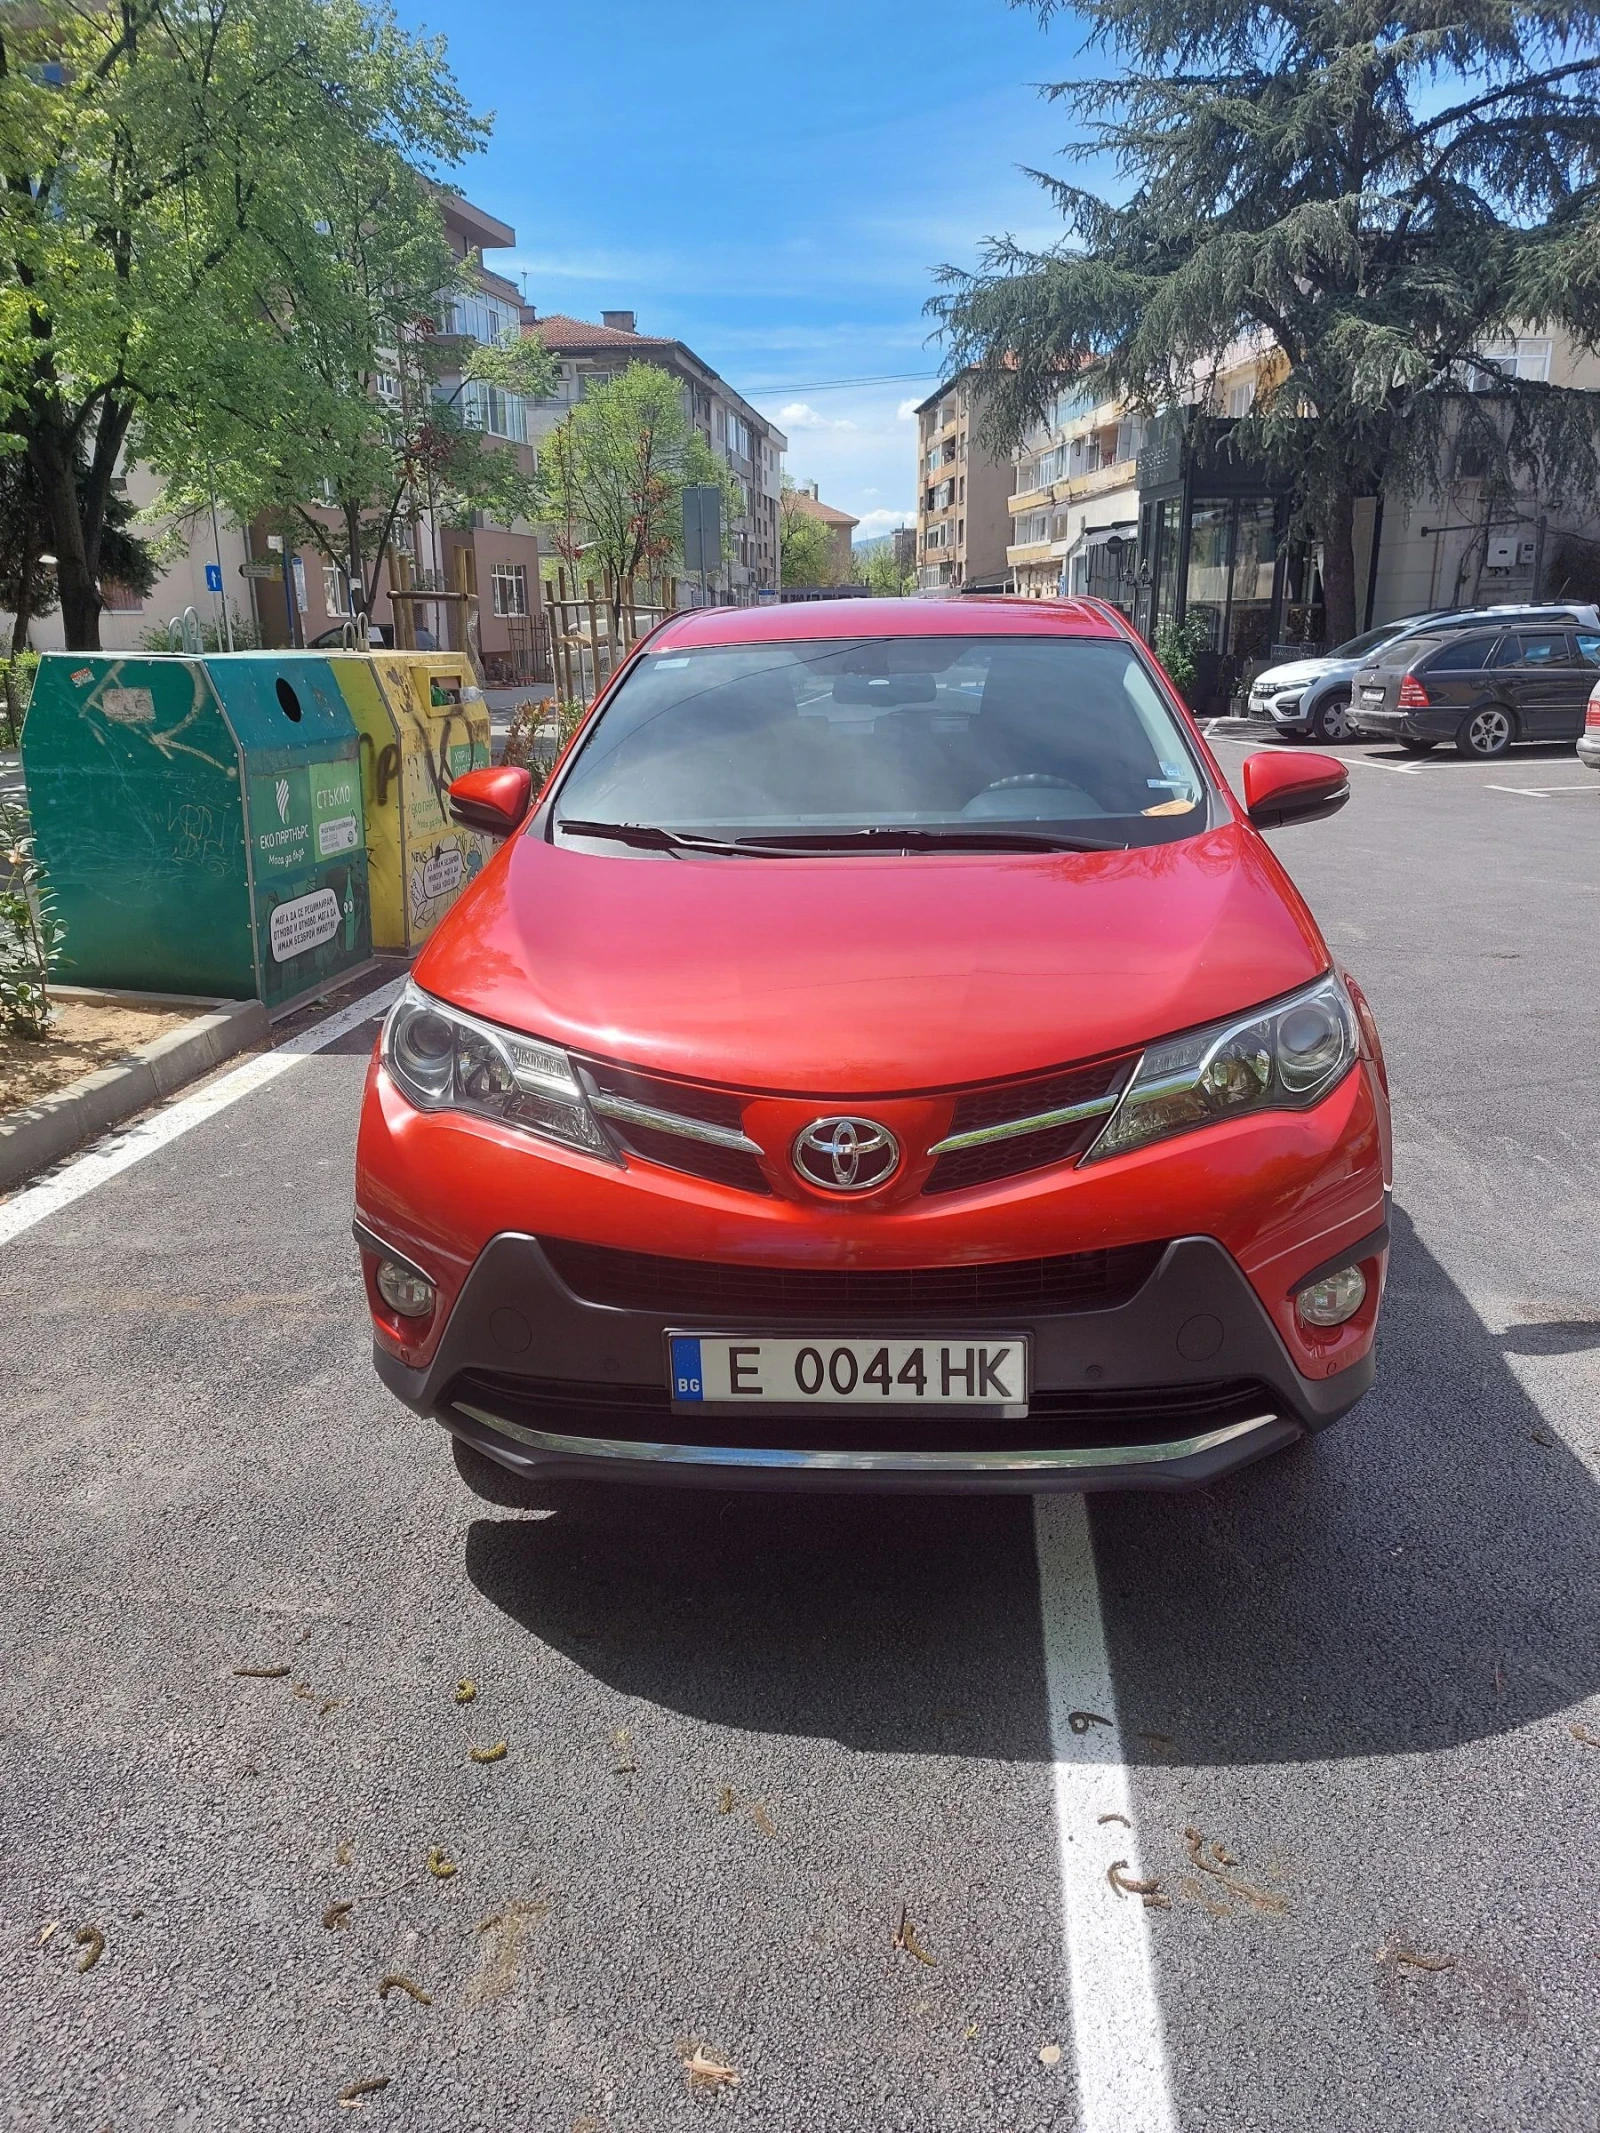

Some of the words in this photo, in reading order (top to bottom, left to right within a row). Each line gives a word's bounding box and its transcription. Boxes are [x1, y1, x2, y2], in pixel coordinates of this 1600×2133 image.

[316, 785, 350, 809] СТЪКЛО
[260, 833, 275, 849] ЕКО
[275, 824, 309, 845] ПАРТНЪРС
[268, 854, 285, 865] Мога
[285, 855, 292, 868] да
[274, 924, 292, 940] ОТНОВО
[293, 922, 298, 931] И
[317, 911, 330, 923] МОГА
[330, 907, 337, 917] ДА
[275, 914, 289, 926] МОГА
[290, 910, 297, 921] ДА
[298, 908, 304, 918] СЕ
[728, 1346, 763, 1395] E
[678, 1378, 700, 1392] BG
